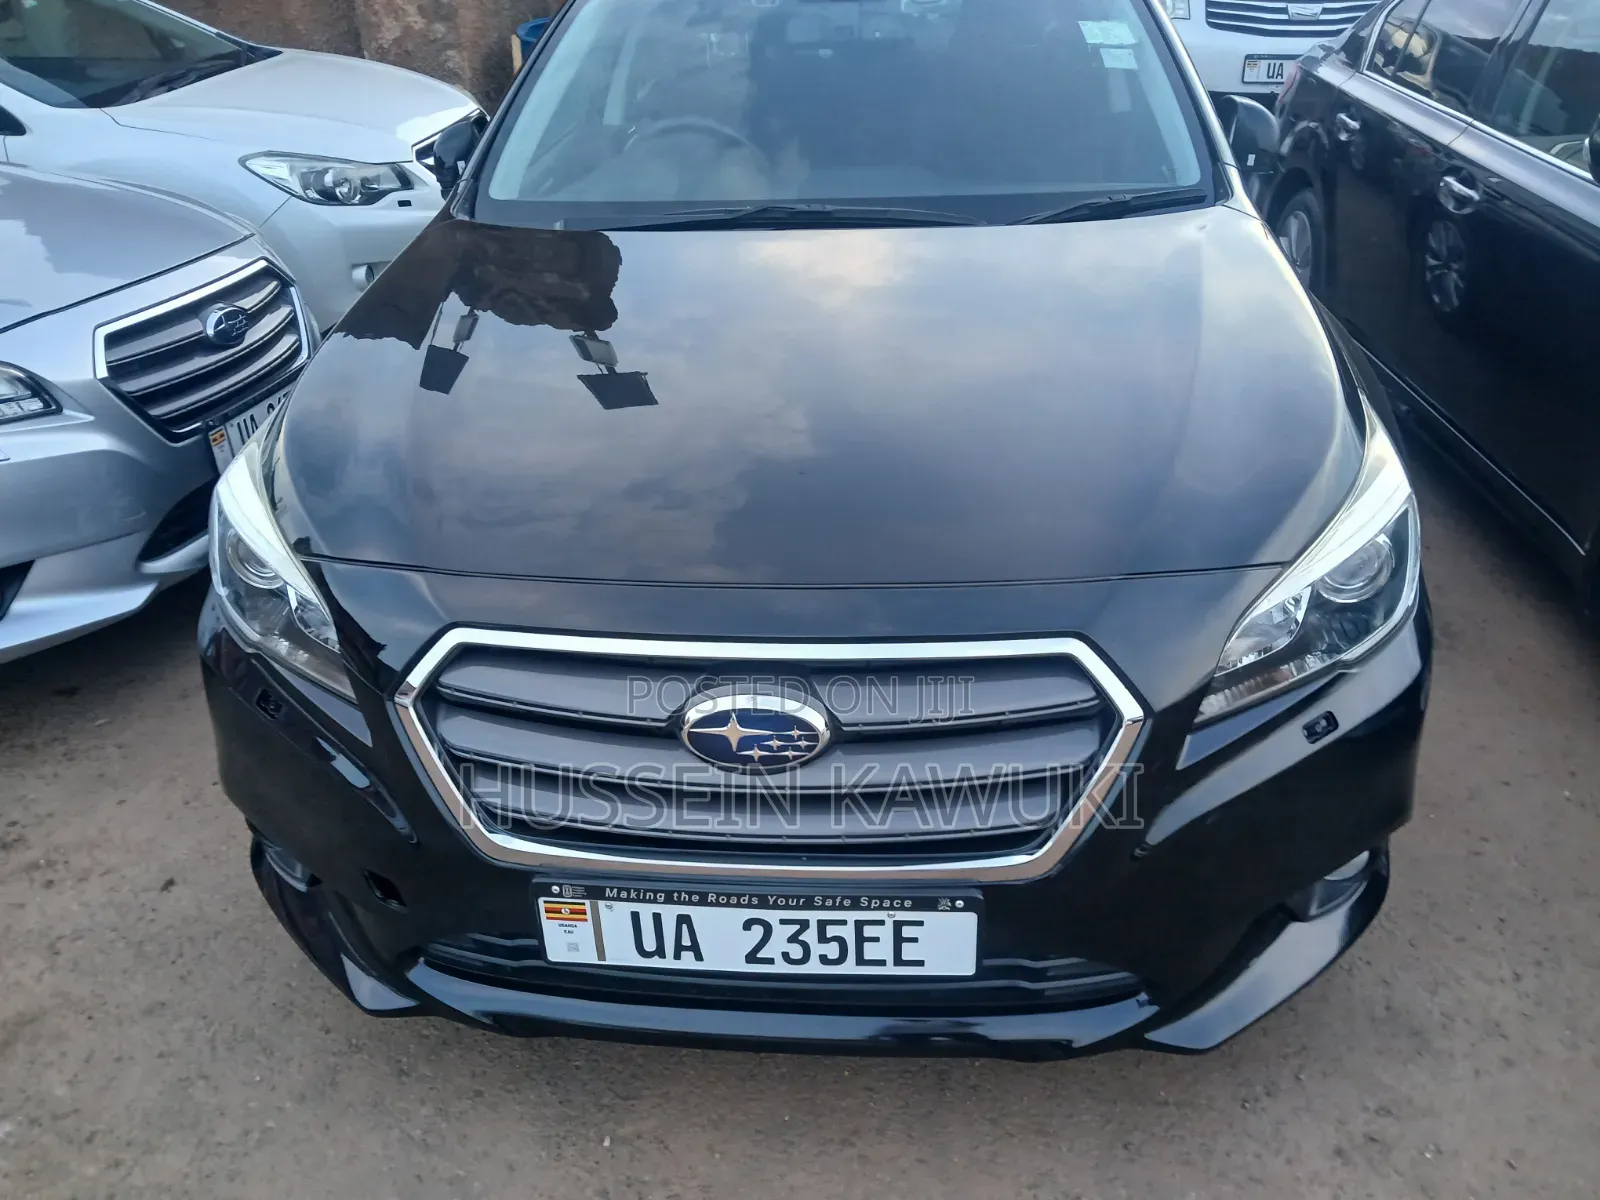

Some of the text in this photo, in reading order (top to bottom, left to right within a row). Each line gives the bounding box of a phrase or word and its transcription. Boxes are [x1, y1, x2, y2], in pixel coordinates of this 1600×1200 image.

[1266, 62, 1284, 80] UA
[605, 887, 913, 909] Making the Roads Your Safe Space
[630, 910, 925, 967] UA 235EE
